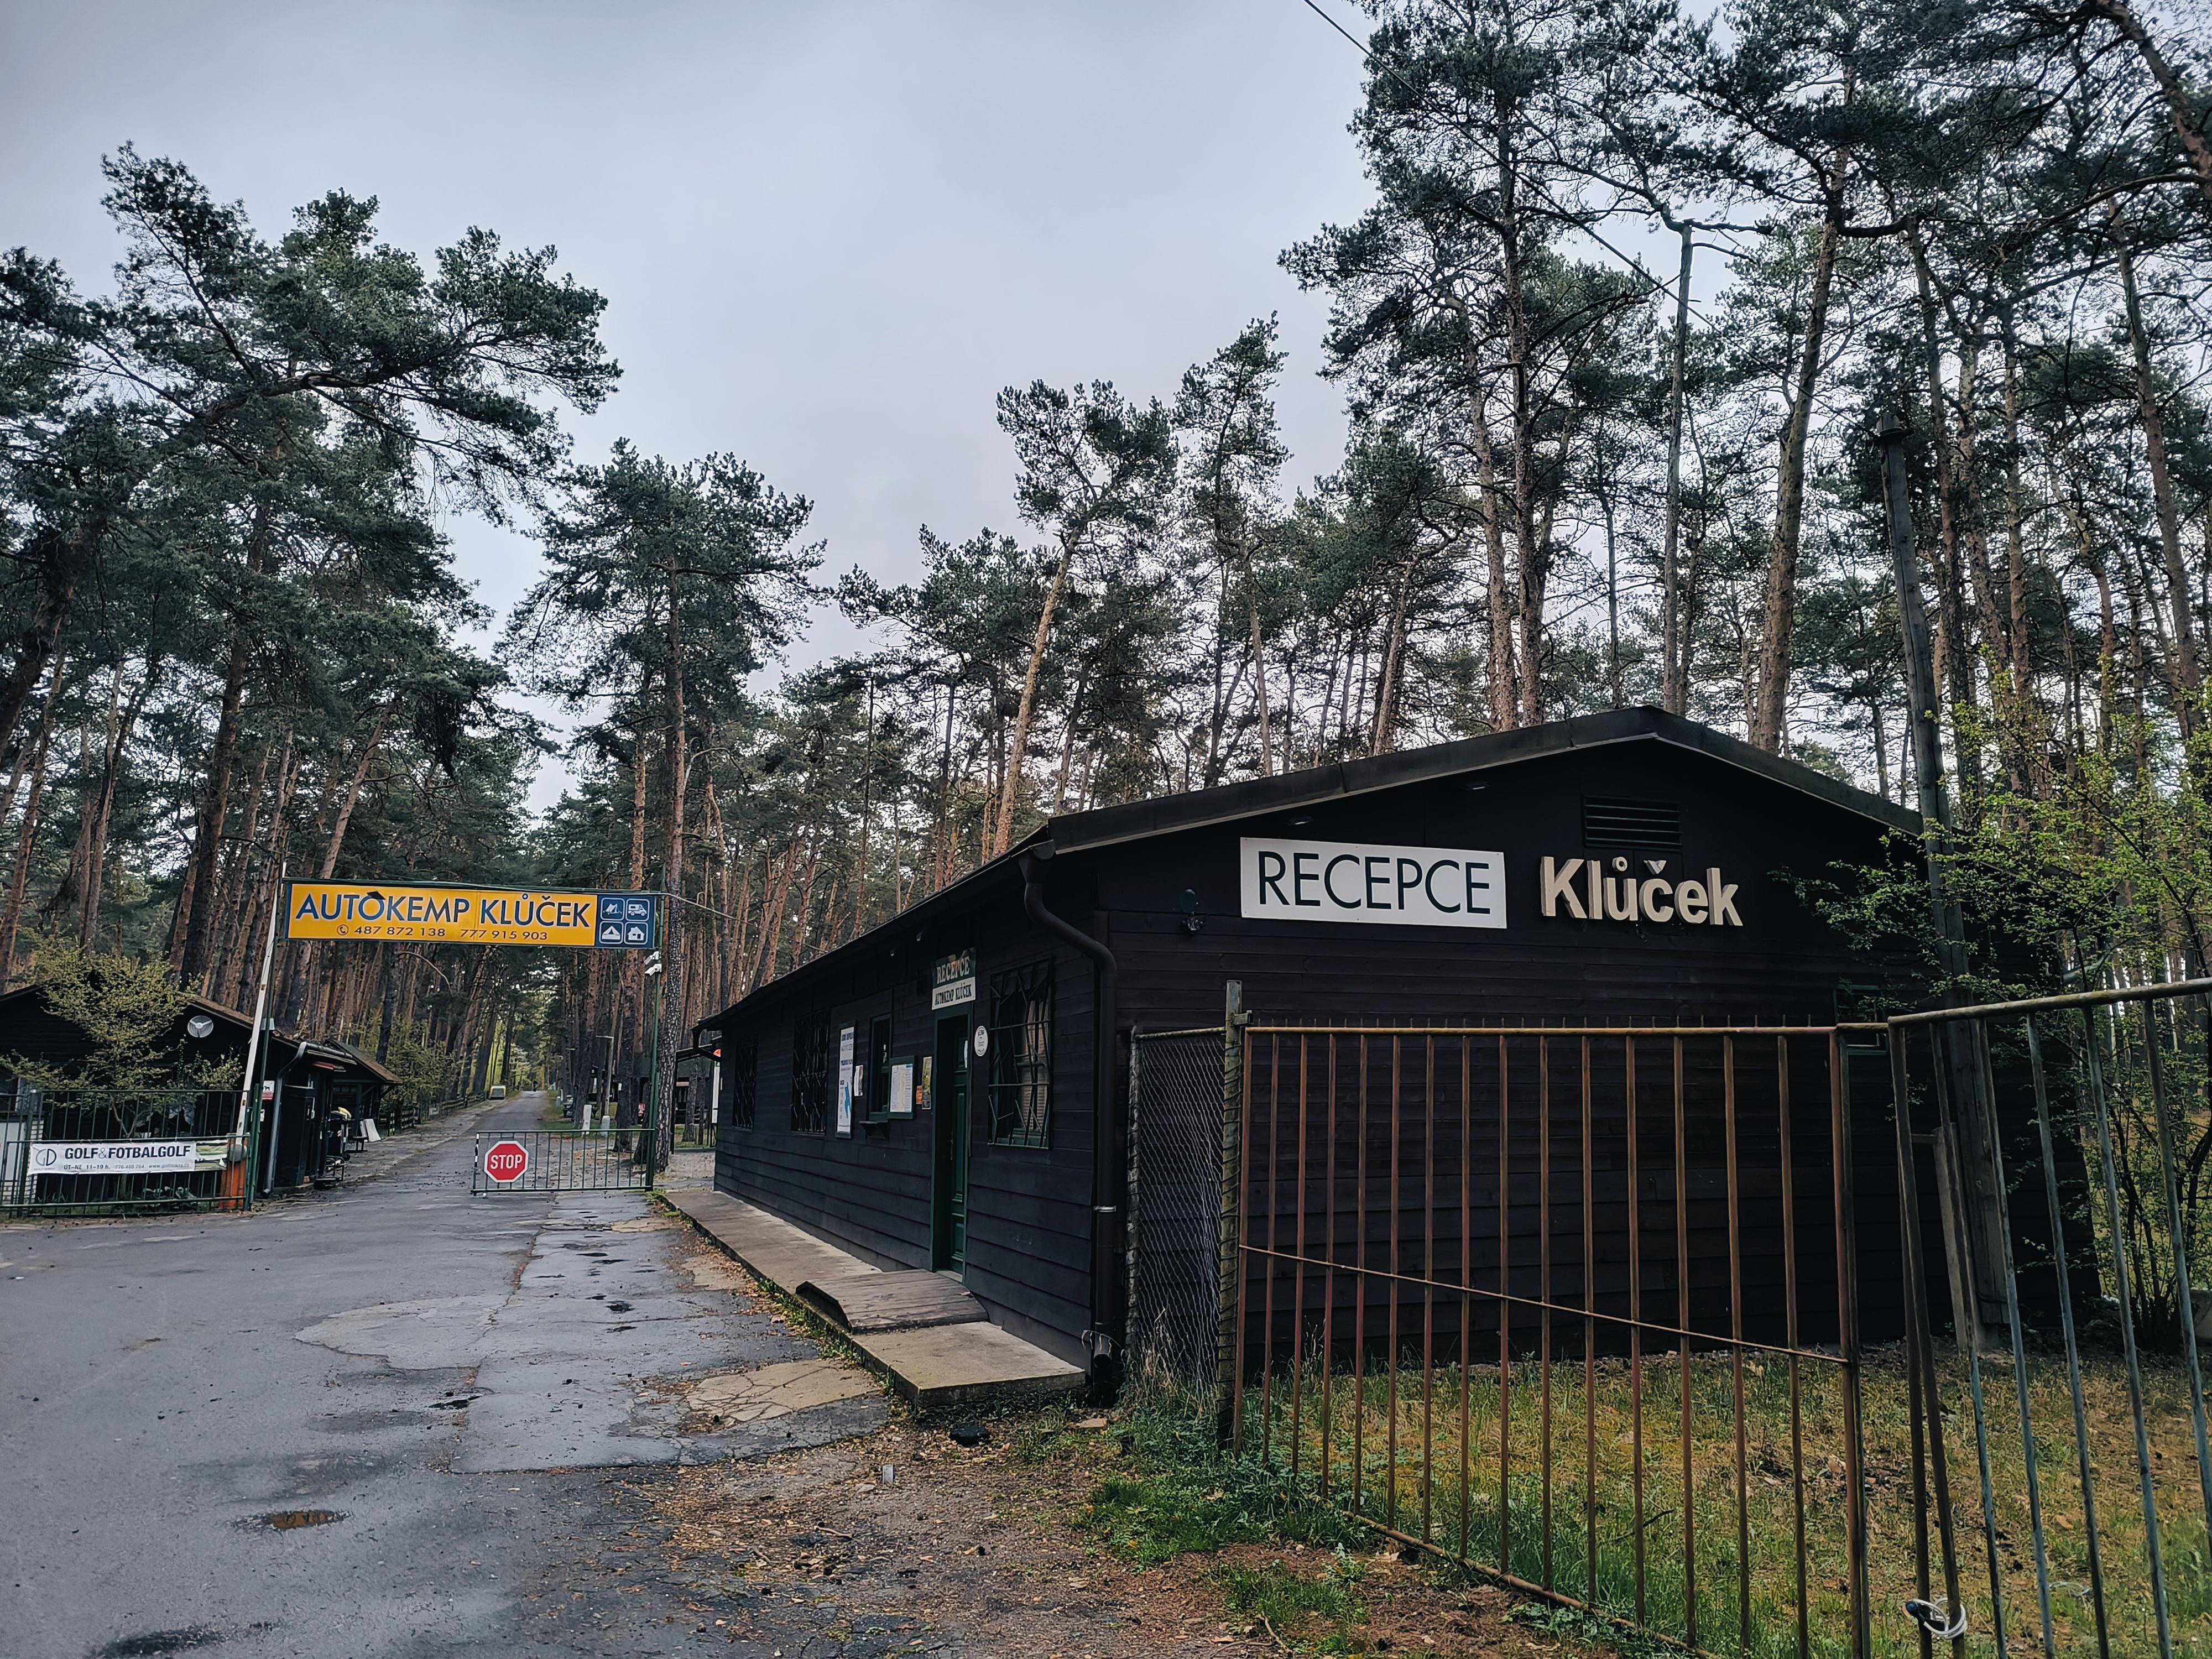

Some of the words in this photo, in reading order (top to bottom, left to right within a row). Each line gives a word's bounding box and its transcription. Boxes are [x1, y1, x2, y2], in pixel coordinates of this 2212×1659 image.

[1258, 851, 1490, 915] RECEPCE
[1541, 855, 1743, 926] Klůček
[295, 893, 470, 923] AUTOKEMP
[480, 893, 591, 928] KLŮČEK
[354, 926, 382, 935] 487
[387, 926, 413, 936] 872
[421, 927, 445, 937] 138
[460, 929, 487, 938] 777
[492, 930, 517, 939] 915
[522, 931, 547, 940] 903
[936, 956, 970, 984] RECEPCE
[65, 1145, 191, 1159] GOLF&FOTBALGOLF
[490, 1154, 523, 1170] STOP
